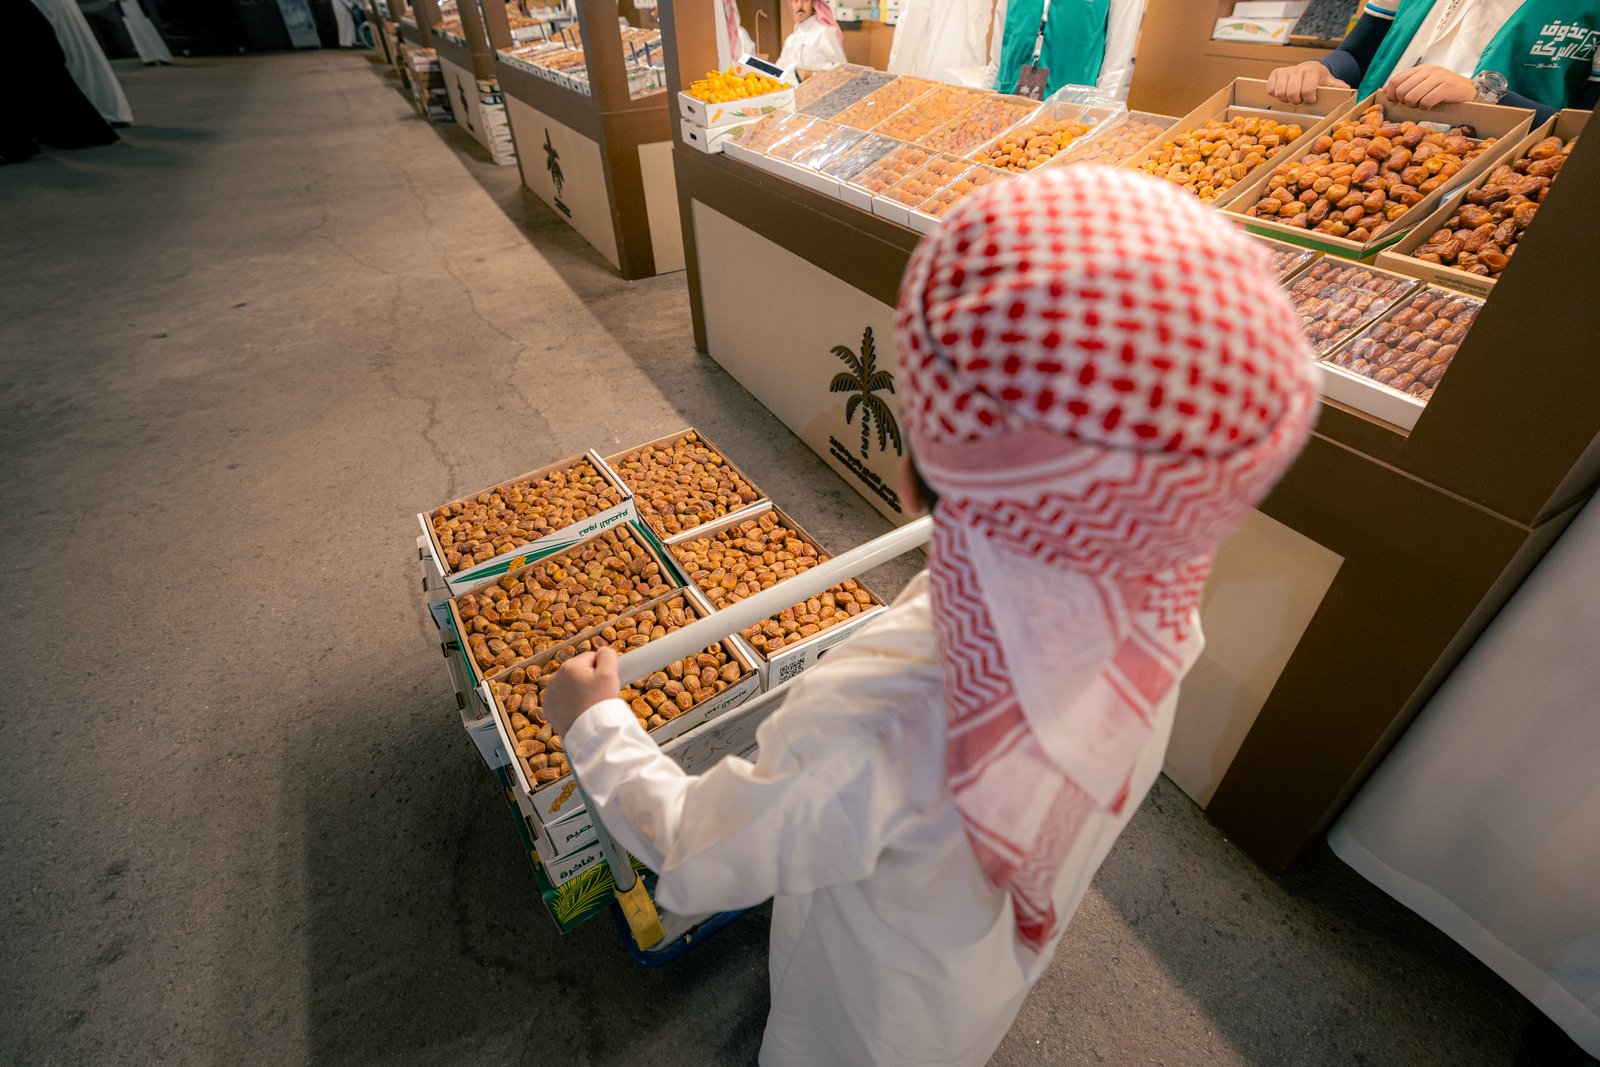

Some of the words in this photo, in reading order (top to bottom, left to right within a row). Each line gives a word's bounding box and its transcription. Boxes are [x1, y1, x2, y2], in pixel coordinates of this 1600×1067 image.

[1540, 20, 1589, 41] عذوق
[1530, 40, 1578, 61] البركة
[579, 522, 598, 537] تمور
[600, 509, 629, 529] القصيم
[560, 855, 595, 879] فاخرة
